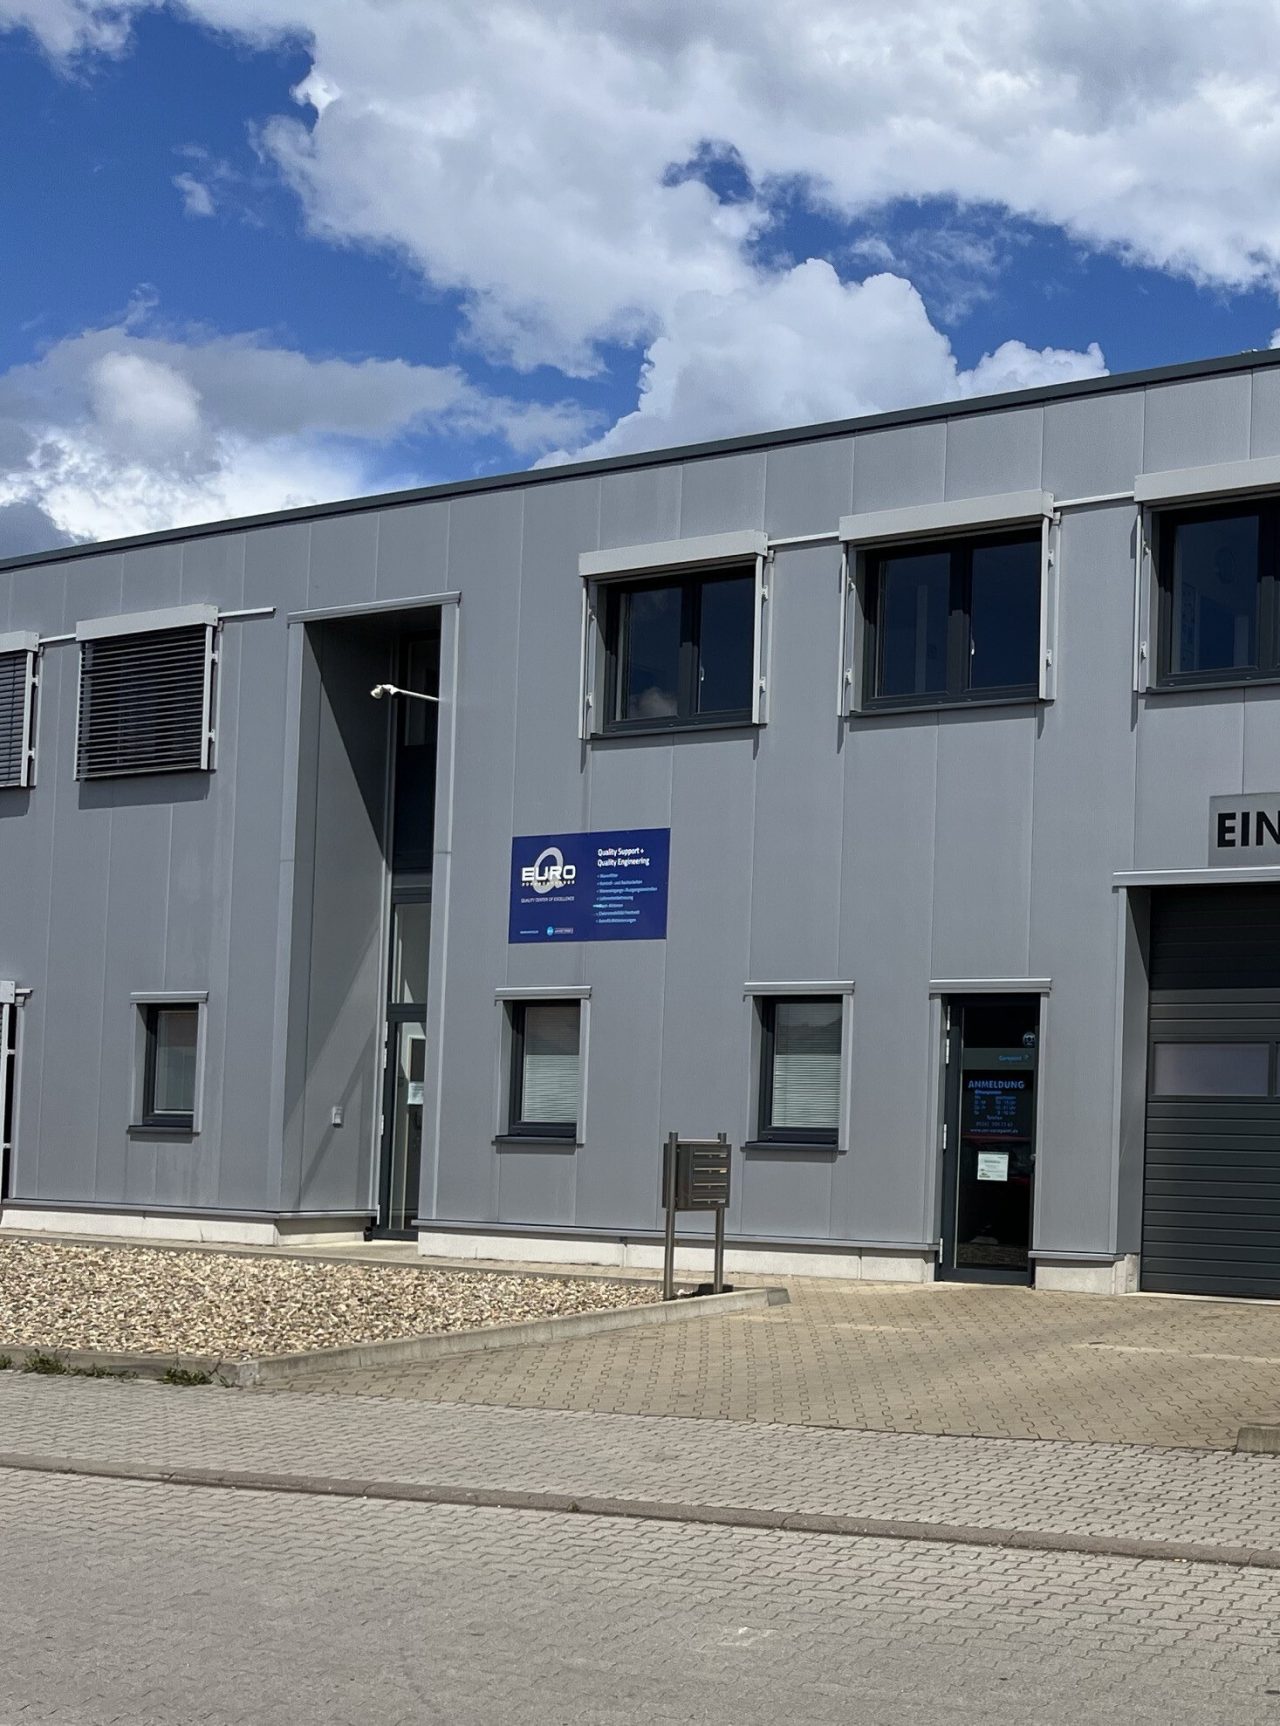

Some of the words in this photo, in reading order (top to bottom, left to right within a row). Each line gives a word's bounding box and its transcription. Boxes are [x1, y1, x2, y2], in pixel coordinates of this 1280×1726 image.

[597, 848, 617, 857] Quality
[617, 847, 640, 856] Support
[597, 858, 617, 868] Quality
[617, 857, 650, 867] Engineering
[521, 864, 576, 881] EURO
[967, 1080, 1025, 1089] ANMELDUNG
